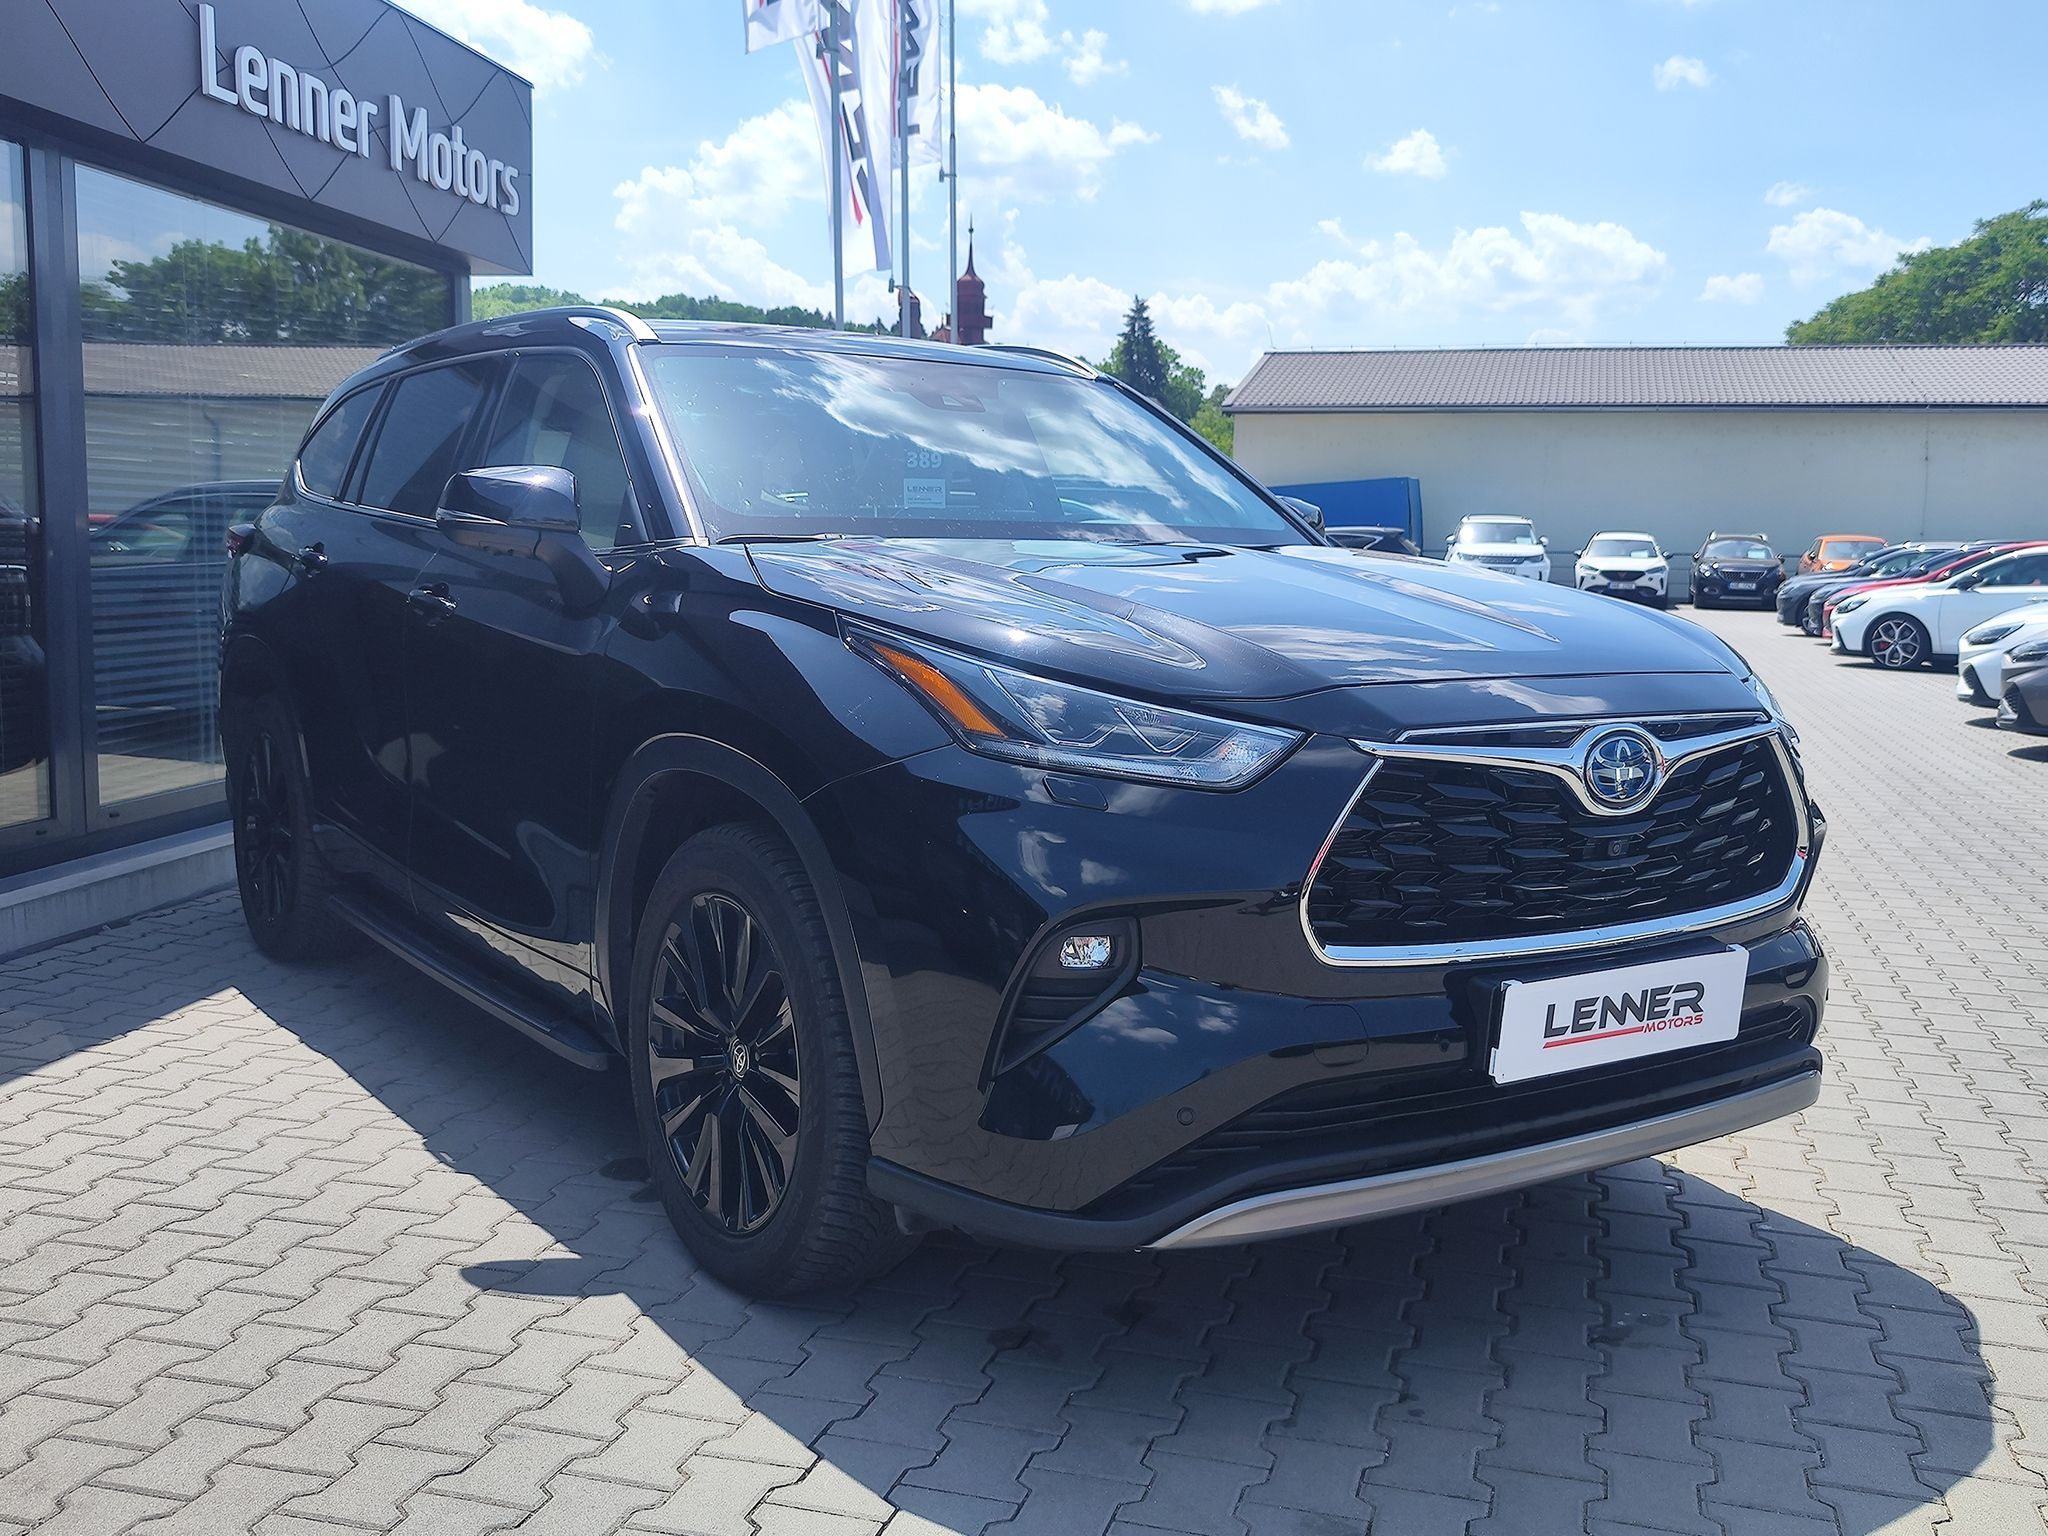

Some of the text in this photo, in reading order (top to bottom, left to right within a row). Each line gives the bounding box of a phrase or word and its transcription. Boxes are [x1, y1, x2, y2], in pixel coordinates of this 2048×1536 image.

[199, 2, 520, 217] Lenner Motors
[906, 451, 942, 469] 389
[1543, 981, 1706, 1039] LENNER
[1643, 1014, 1704, 1034] MOTORS
